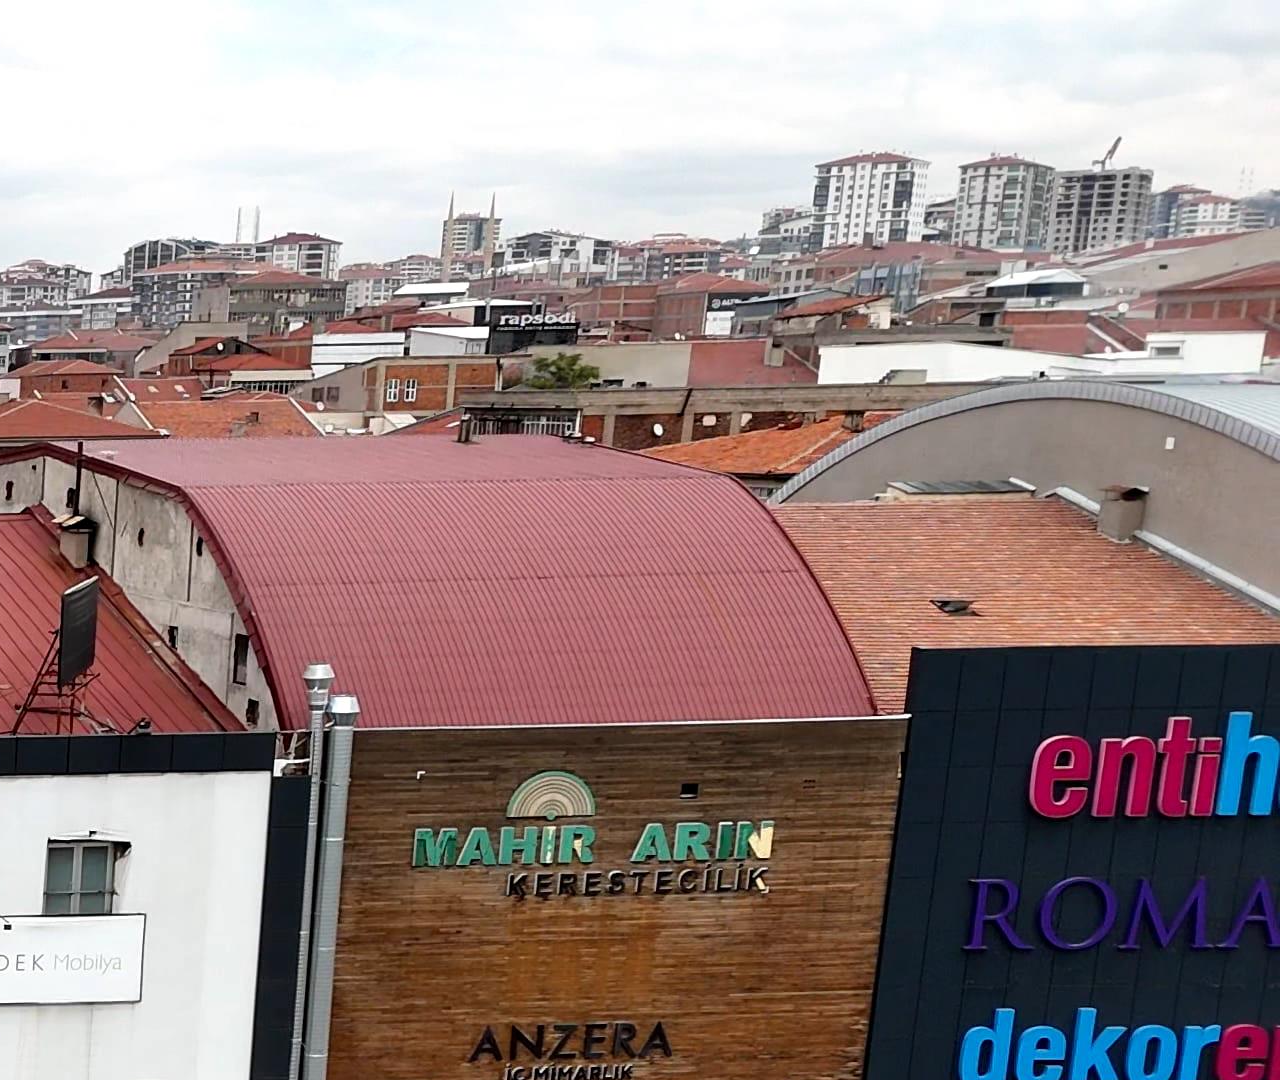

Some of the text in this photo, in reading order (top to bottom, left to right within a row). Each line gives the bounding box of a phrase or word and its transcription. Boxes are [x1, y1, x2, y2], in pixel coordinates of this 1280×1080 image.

[499, 311, 576, 327] rapsodi
[54, 952, 122, 974] Mobilya
[468, 1021, 673, 1062] ANZERA
